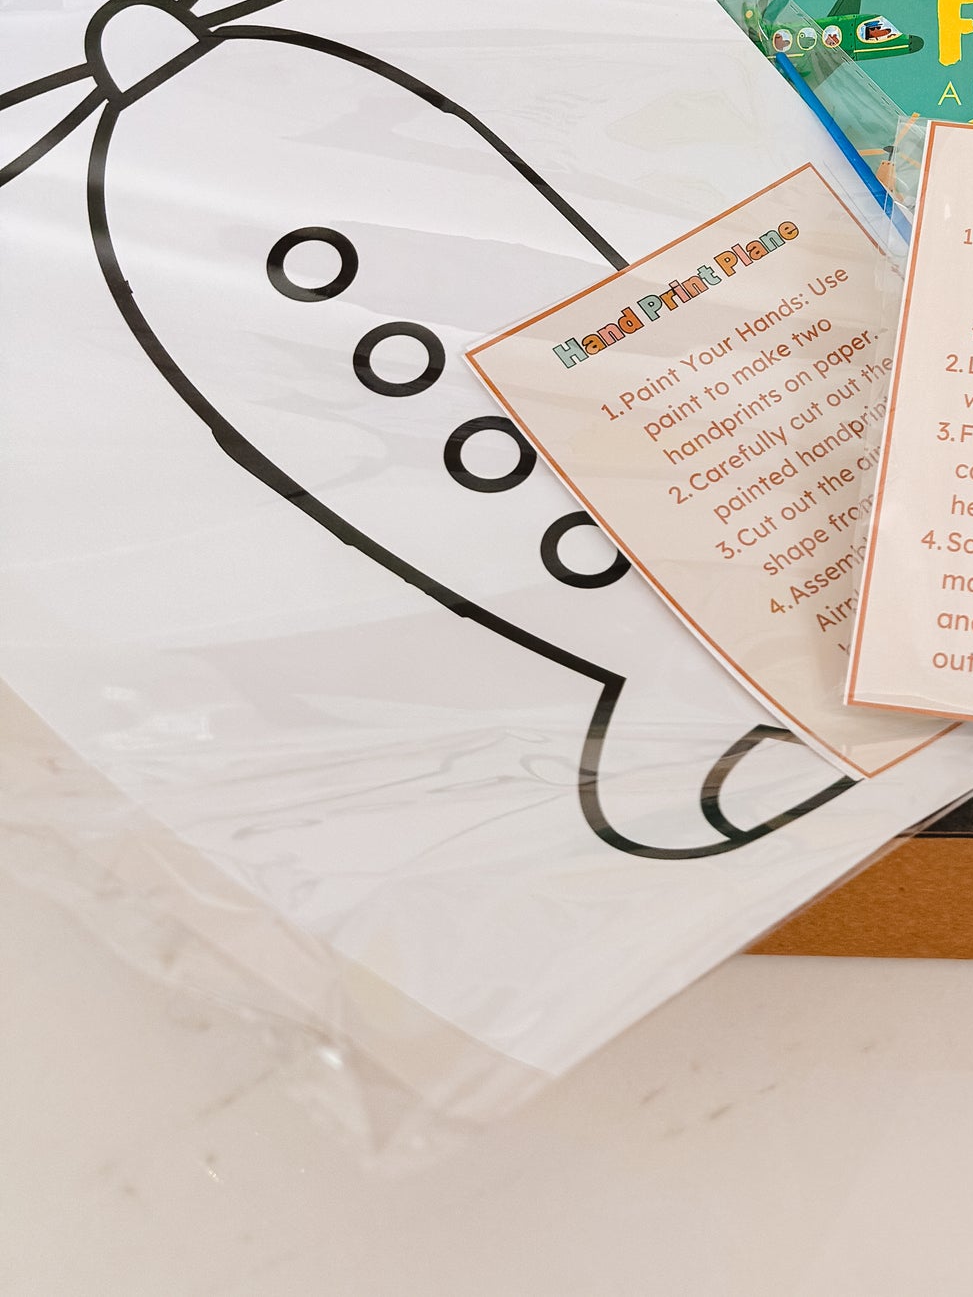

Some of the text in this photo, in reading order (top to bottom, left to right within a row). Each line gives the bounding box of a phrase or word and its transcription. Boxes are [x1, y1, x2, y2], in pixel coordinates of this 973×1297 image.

[938, 81, 960, 106] A
[552, 220, 800, 369] Hand Print Plane
[679, 268, 849, 373] Your Hands: Use
[642, 318, 833, 443] paint to make two
[662, 329, 879, 466] handprints on paper.
[789, 357, 894, 431] cut out the
[712, 457, 800, 526] painted
